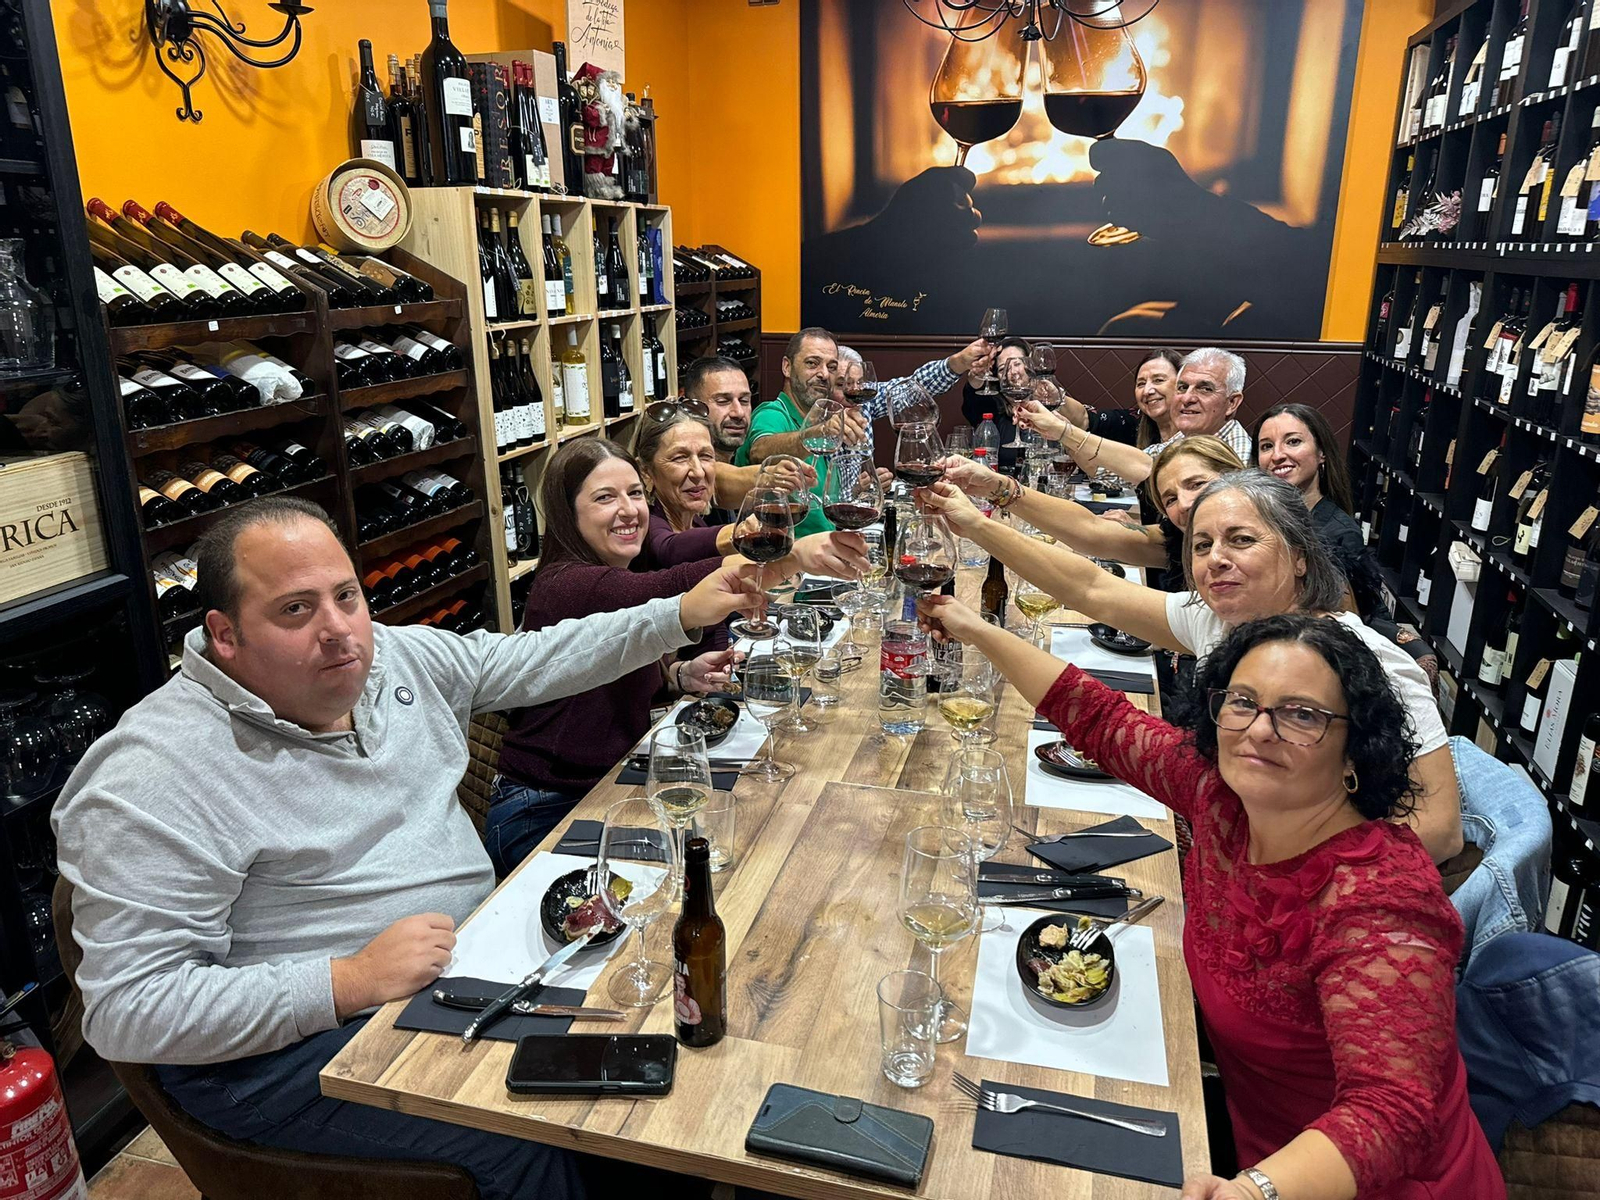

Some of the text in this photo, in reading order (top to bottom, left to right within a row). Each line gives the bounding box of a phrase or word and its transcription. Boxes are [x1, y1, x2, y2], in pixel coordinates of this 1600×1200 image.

[571, 23, 623, 56] Antonia
[822, 283, 841, 294] El
[864, 296, 872, 305] de
[36, 498, 72, 512] DESDE 1912
[0, 509, 80, 552] RICA
